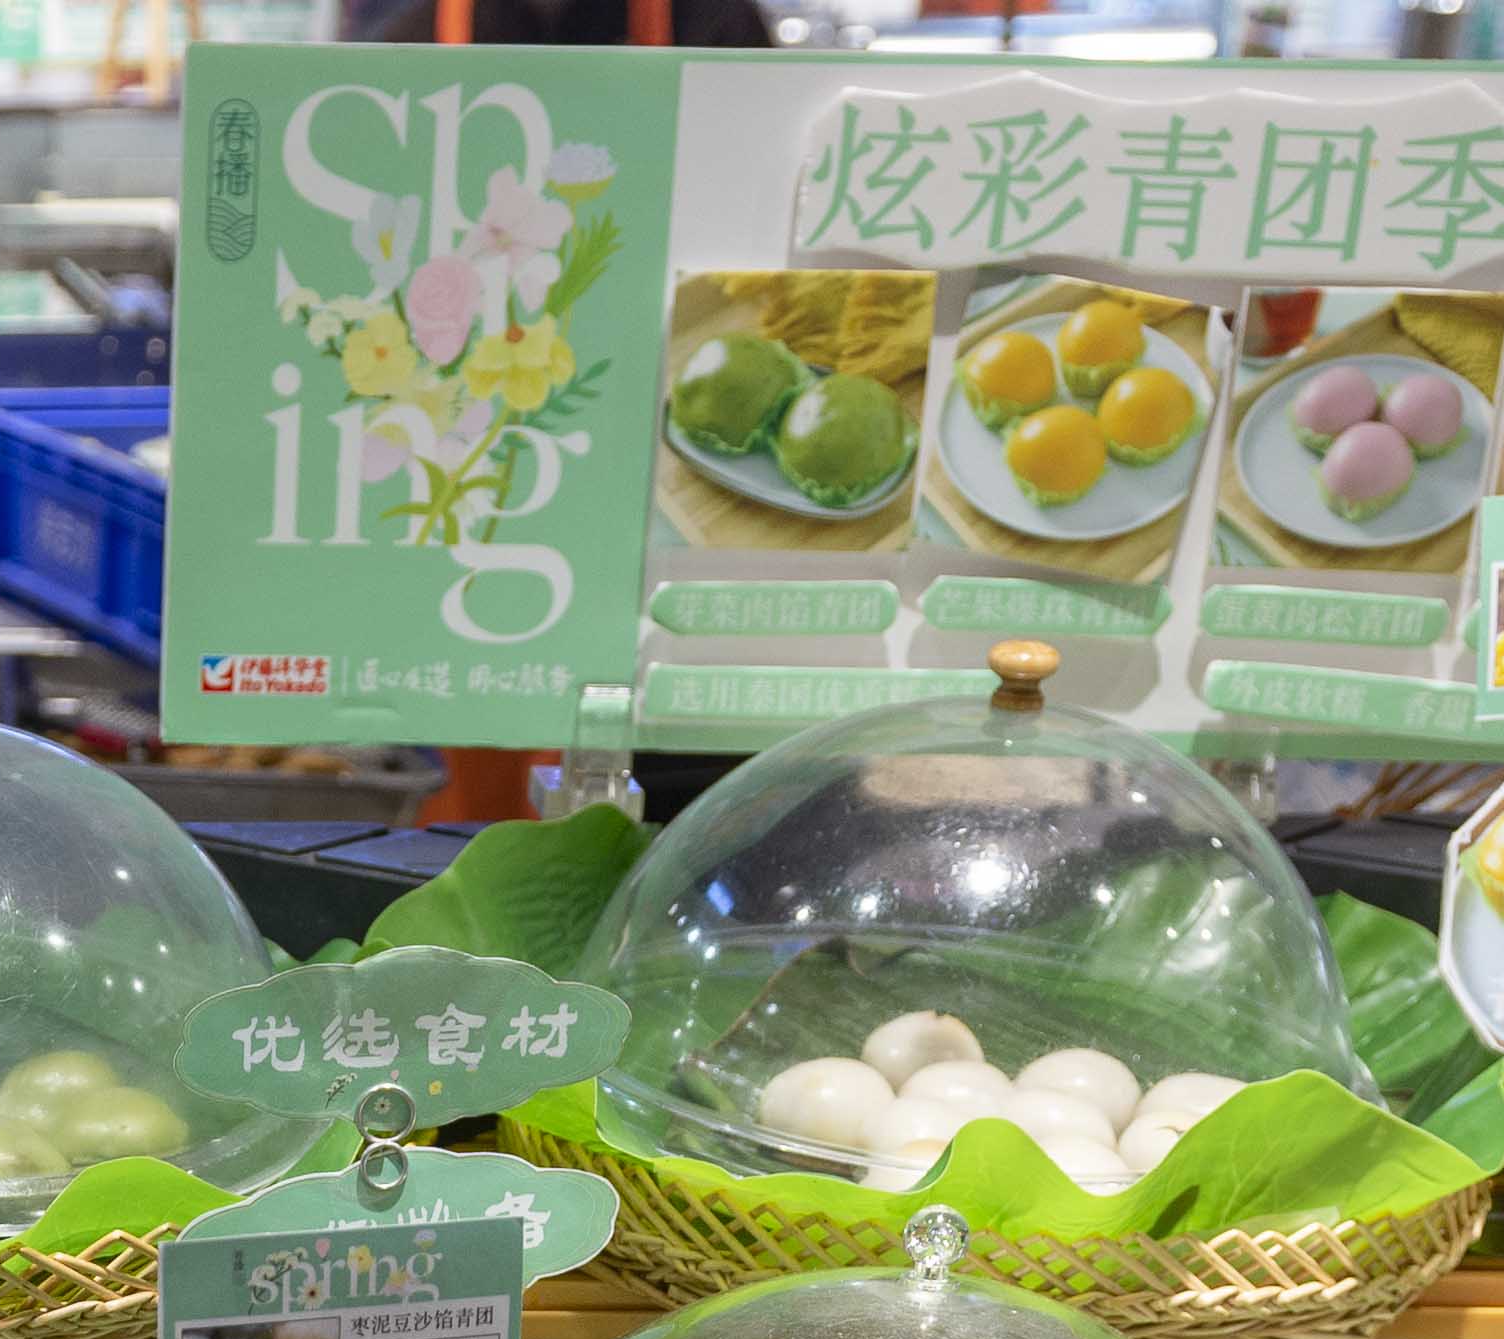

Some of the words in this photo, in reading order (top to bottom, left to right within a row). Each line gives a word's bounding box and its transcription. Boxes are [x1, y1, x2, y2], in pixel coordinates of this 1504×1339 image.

[213, 108, 257, 197] 春播
[238, 679, 263, 694] Ito
[266, 678, 328, 694] Yokado
[230, 1002, 579, 1073] 优选食材
[246, 1241, 443, 1313] spring
[351, 1306, 495, 1336] 枣泥豆沙馅青团
